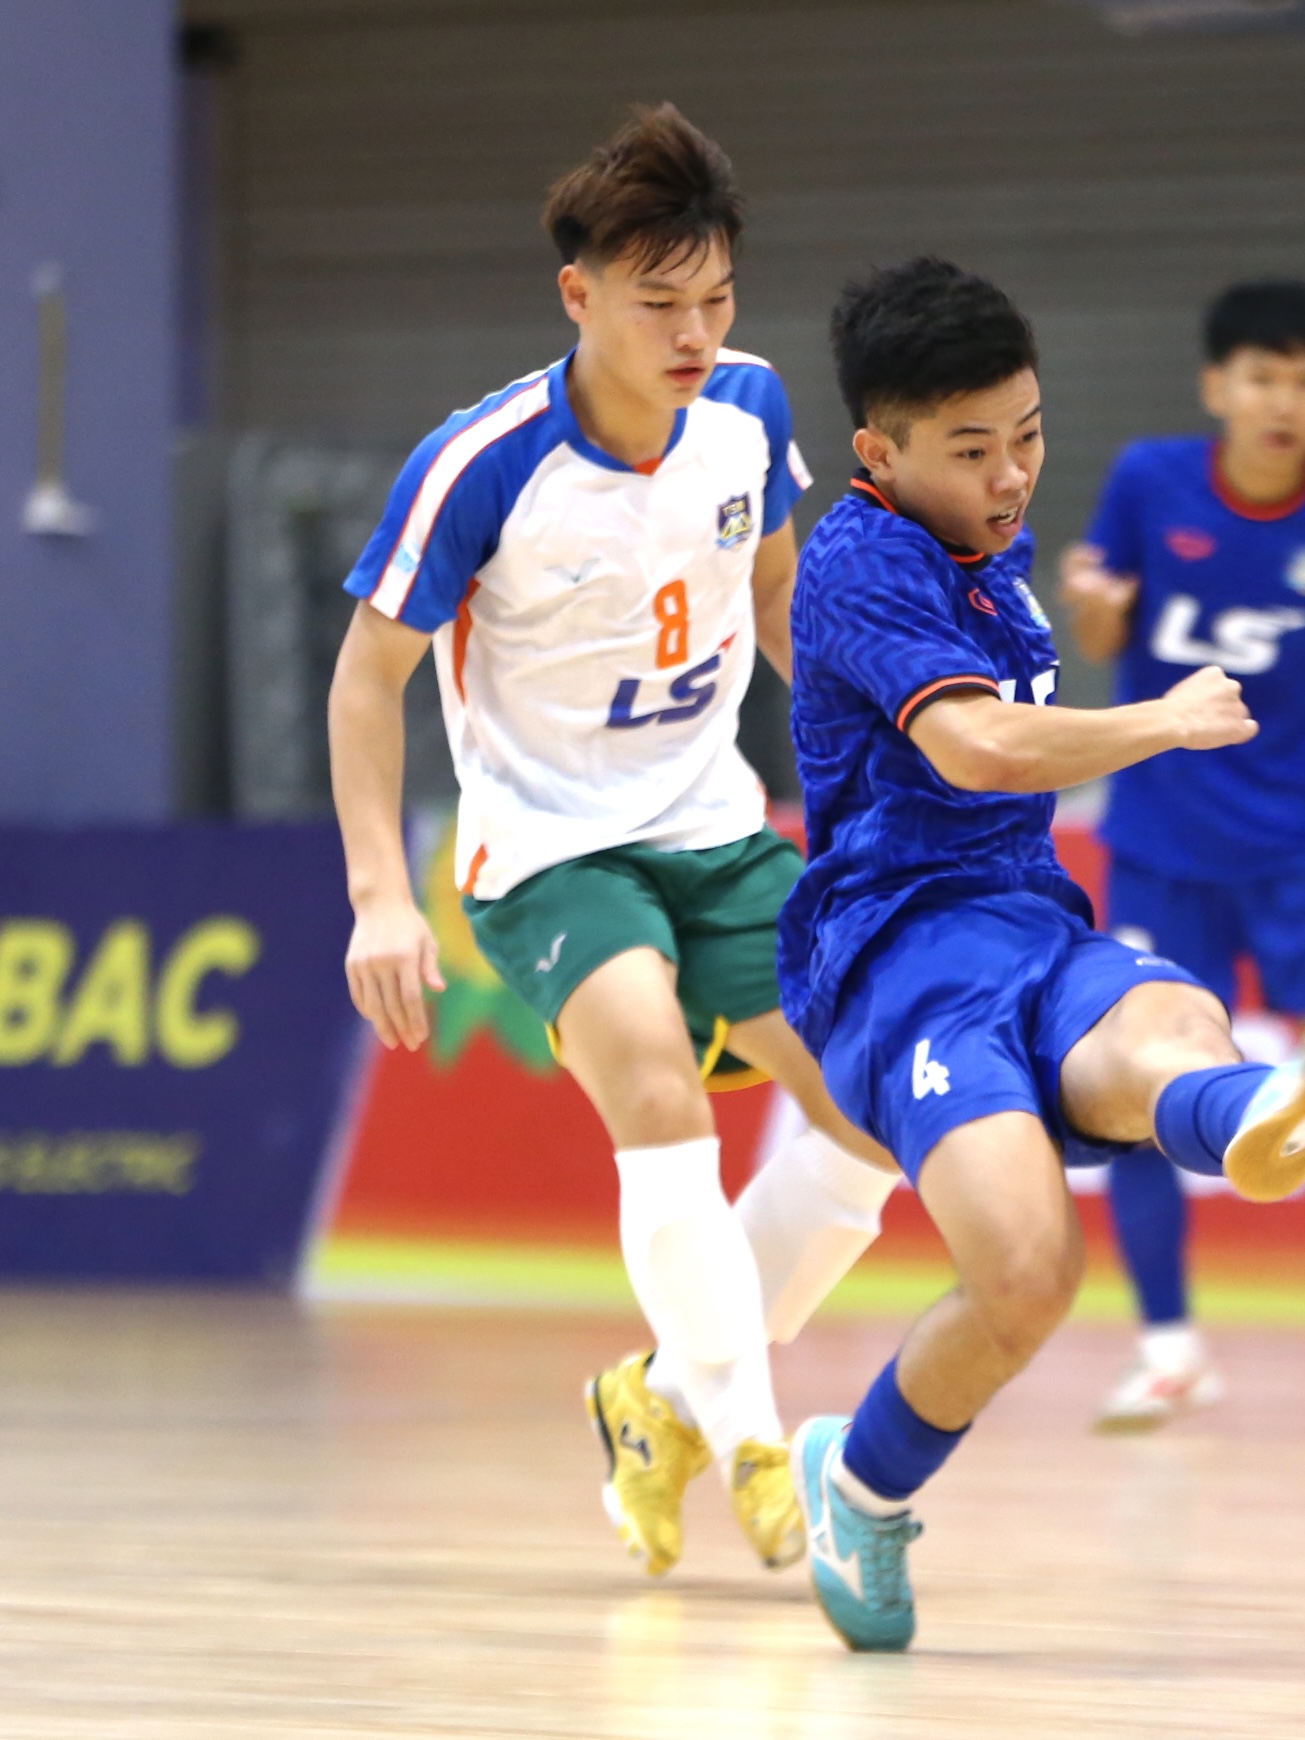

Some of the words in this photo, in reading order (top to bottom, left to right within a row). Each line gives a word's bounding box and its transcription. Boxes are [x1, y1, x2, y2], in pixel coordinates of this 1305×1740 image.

[654, 578, 690, 671] 8
[605, 652, 722, 729] LS
[912, 1038, 951, 1100] 4
